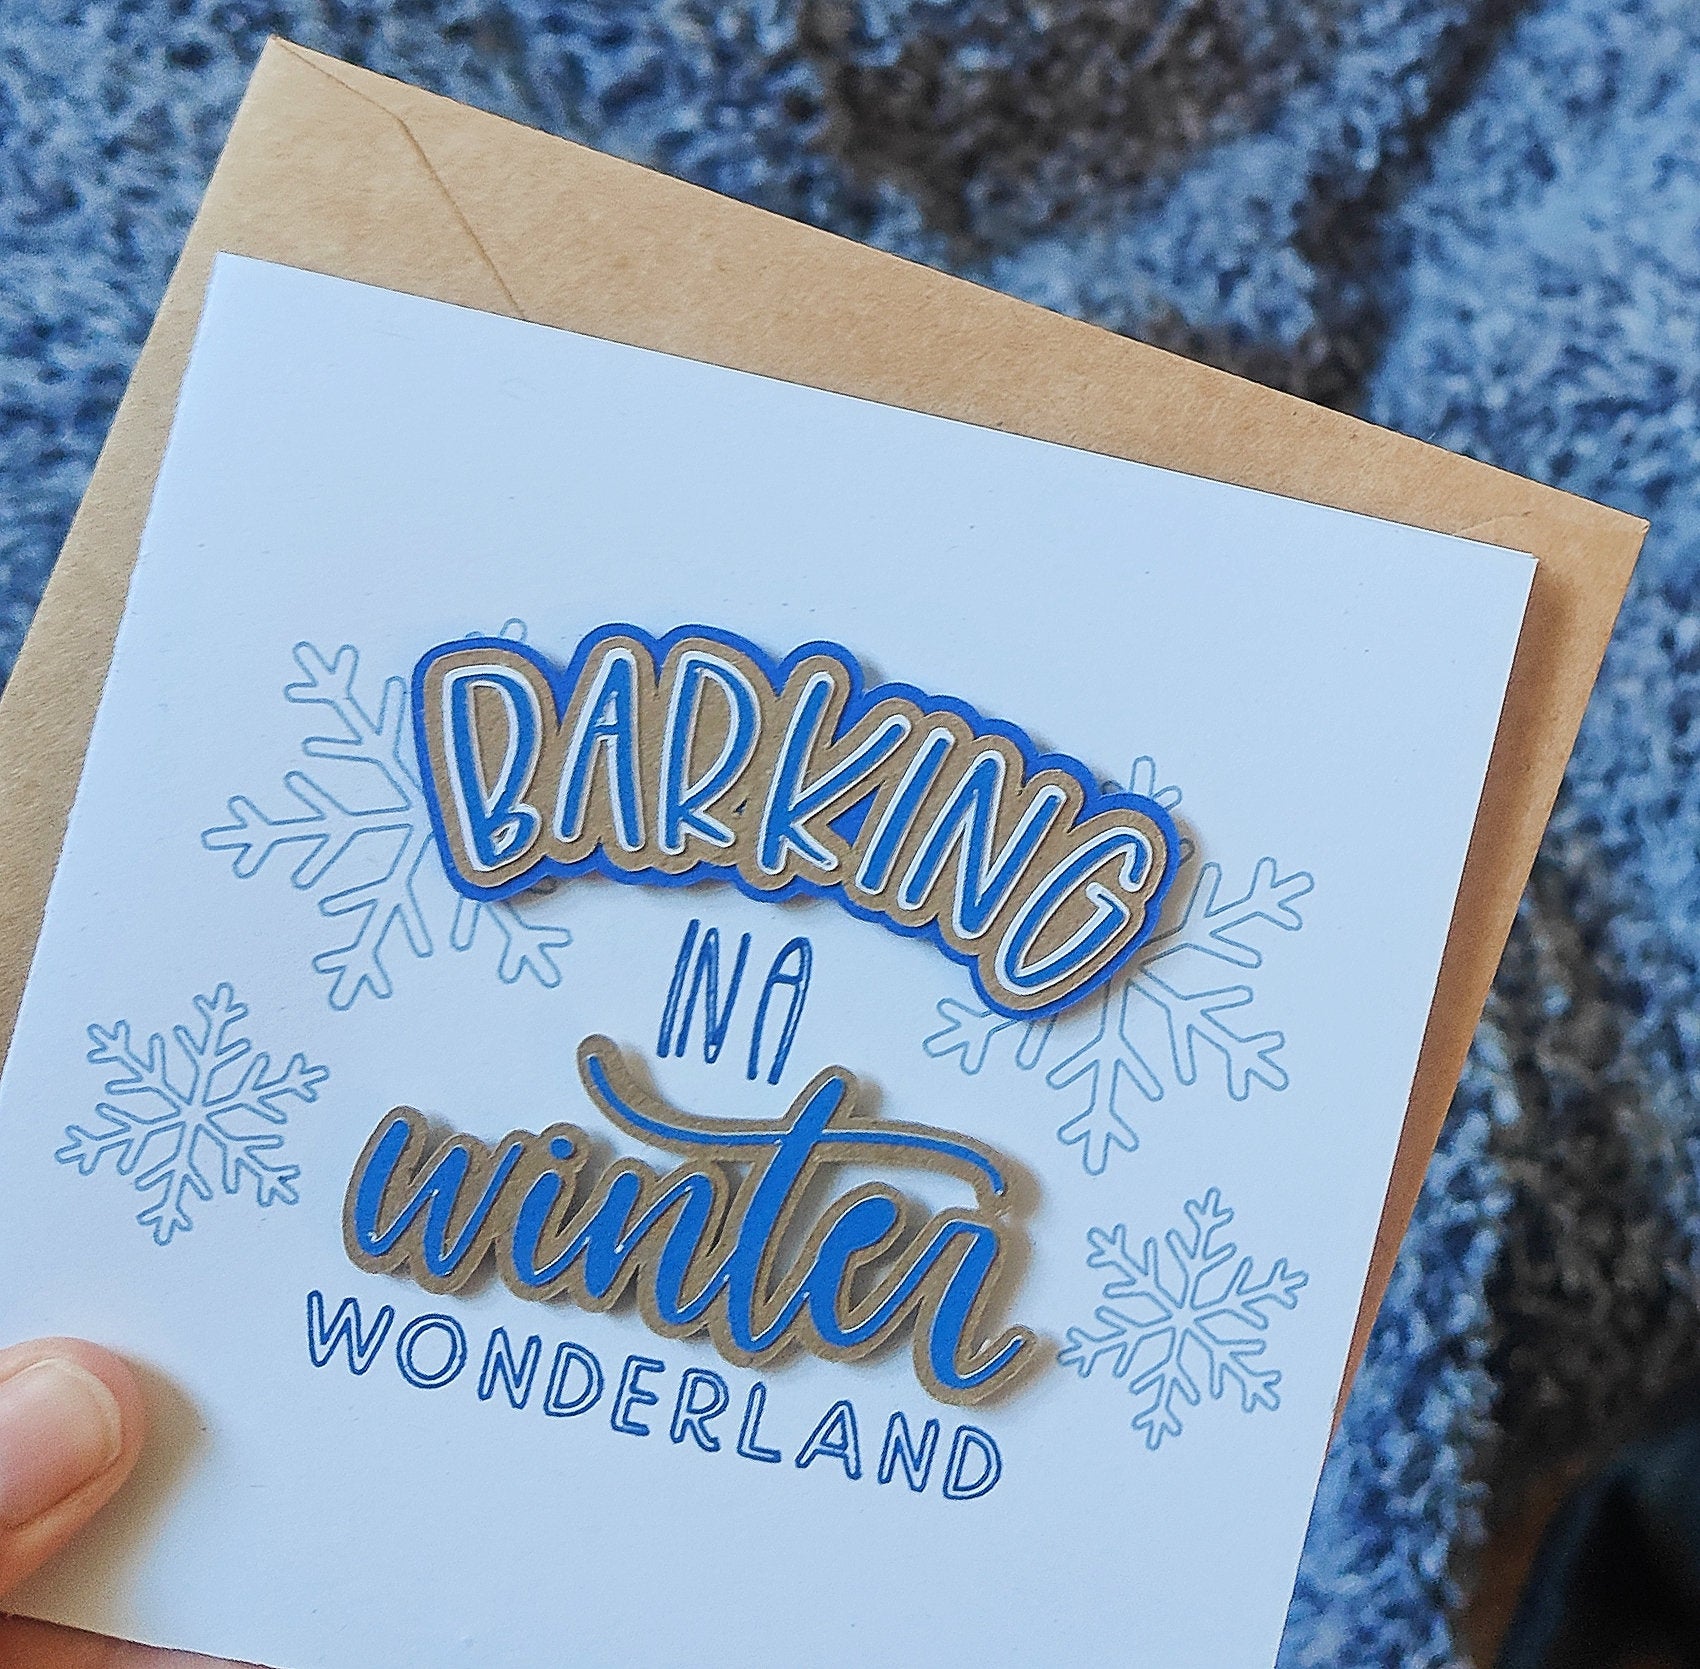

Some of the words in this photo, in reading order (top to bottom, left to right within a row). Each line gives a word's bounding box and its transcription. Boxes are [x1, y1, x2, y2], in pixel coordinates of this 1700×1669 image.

[442, 647, 1150, 995] BARKING
[658, 919, 752, 1063] IN
[747, 935, 812, 1084] A
[353, 1055, 1025, 1390] winter
[306, 1290, 1002, 1501] WONDERLAND
